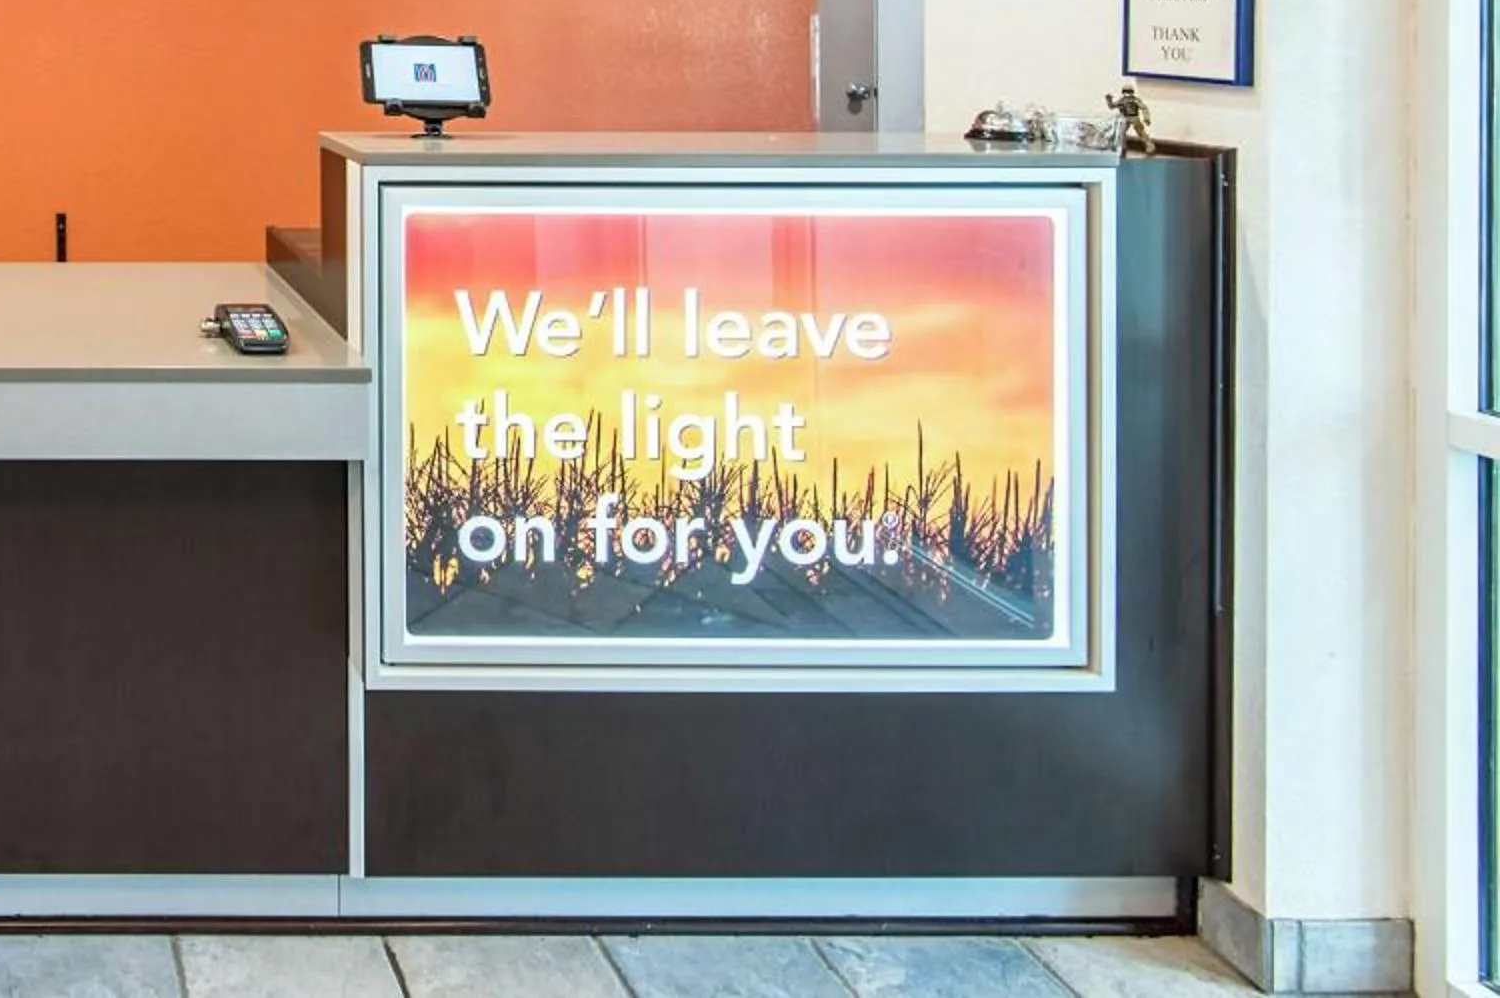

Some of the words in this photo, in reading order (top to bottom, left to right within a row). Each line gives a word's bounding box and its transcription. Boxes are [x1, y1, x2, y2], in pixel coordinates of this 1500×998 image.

[1152, 25, 1201, 42] THANK
[1160, 46, 1191, 62] YOU
[453, 287, 649, 359] We'll
[683, 287, 893, 360] leave
[455, 390, 587, 461] the
[622, 390, 806, 481] light
[457, 513, 556, 564] on
[593, 492, 705, 564] for
